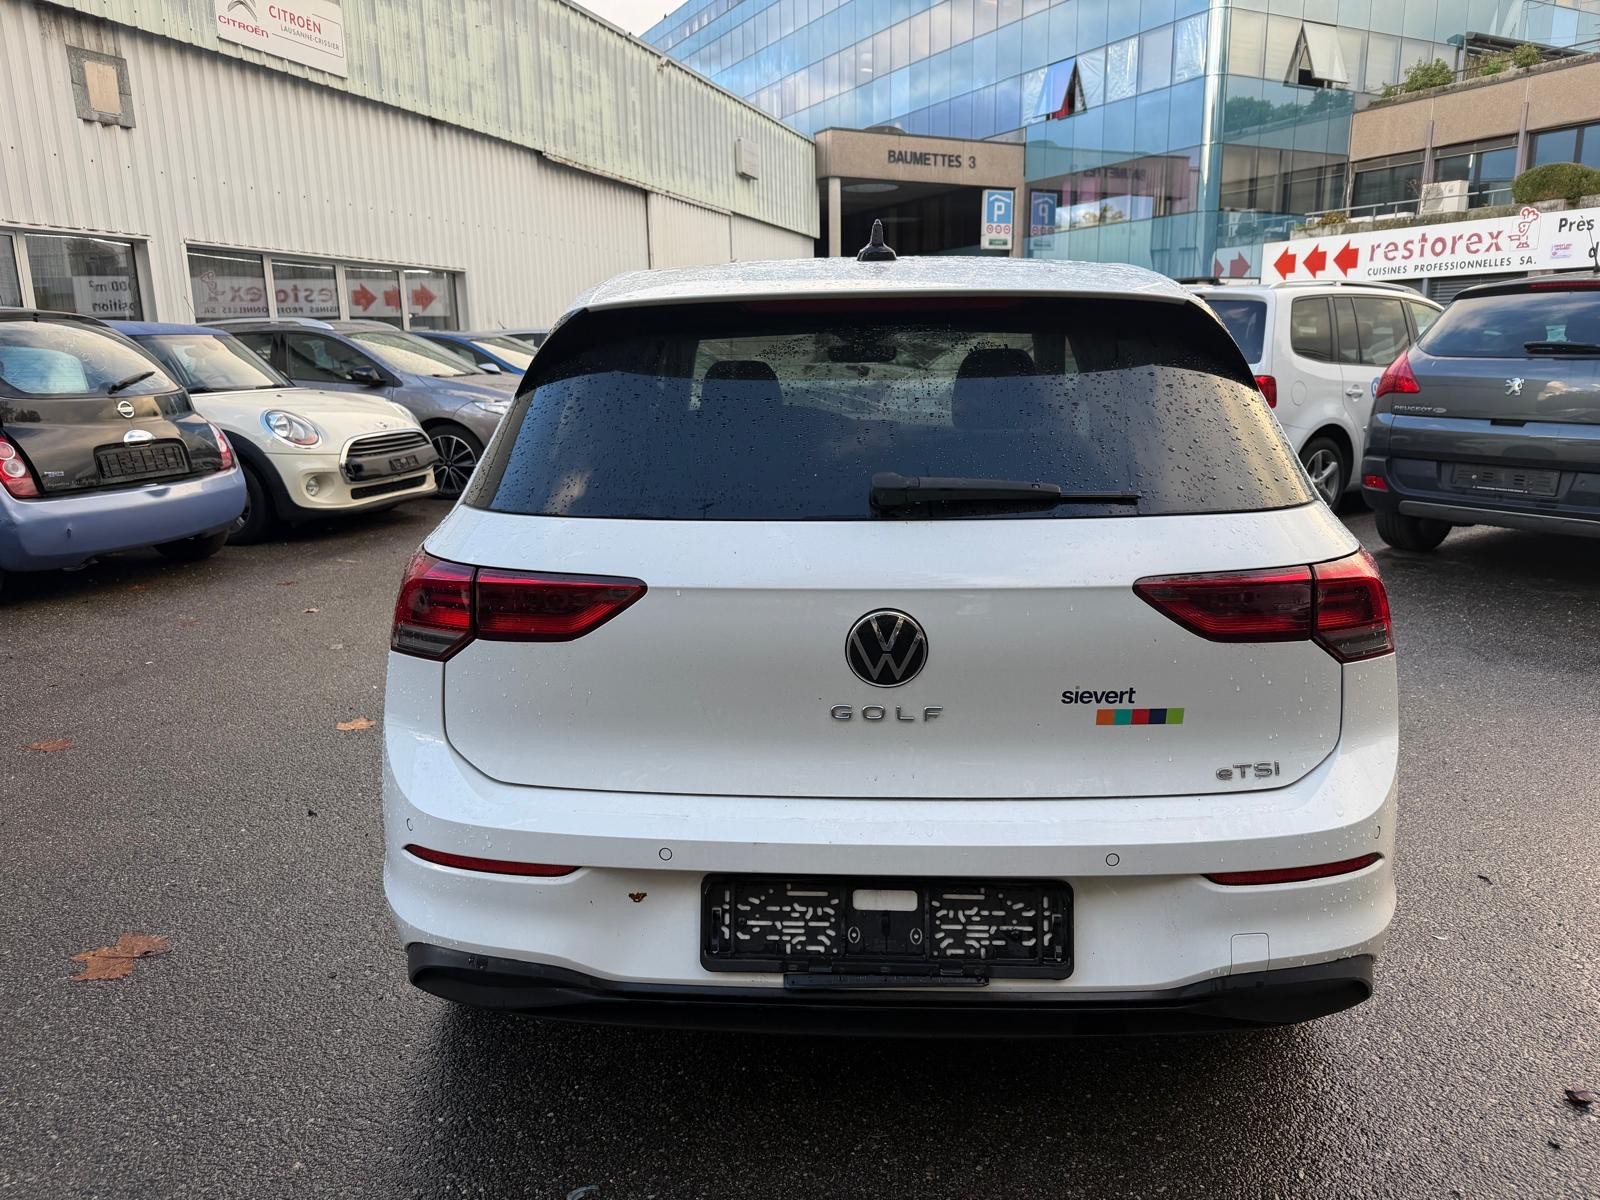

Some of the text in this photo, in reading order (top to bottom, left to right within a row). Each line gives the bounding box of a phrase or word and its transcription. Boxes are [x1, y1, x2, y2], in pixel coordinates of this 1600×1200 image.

[268, 5, 322, 35] CITROËN
[280, 24, 340, 51] LAUSANNE-CRISSIER
[888, 150, 976, 169] BAUMETTES 3
[993, 201, 1005, 222] P
[1558, 215, 1595, 233] Près
[1368, 230, 1504, 262] restorex
[1367, 255, 1537, 276] CUISINES PROFESSIONNELLES SA.
[1394, 404, 1433, 413] PEUGEOT
[1060, 685, 1137, 704] sievert
[831, 704, 944, 722] GOLF
[1216, 761, 1280, 780] eTSI
